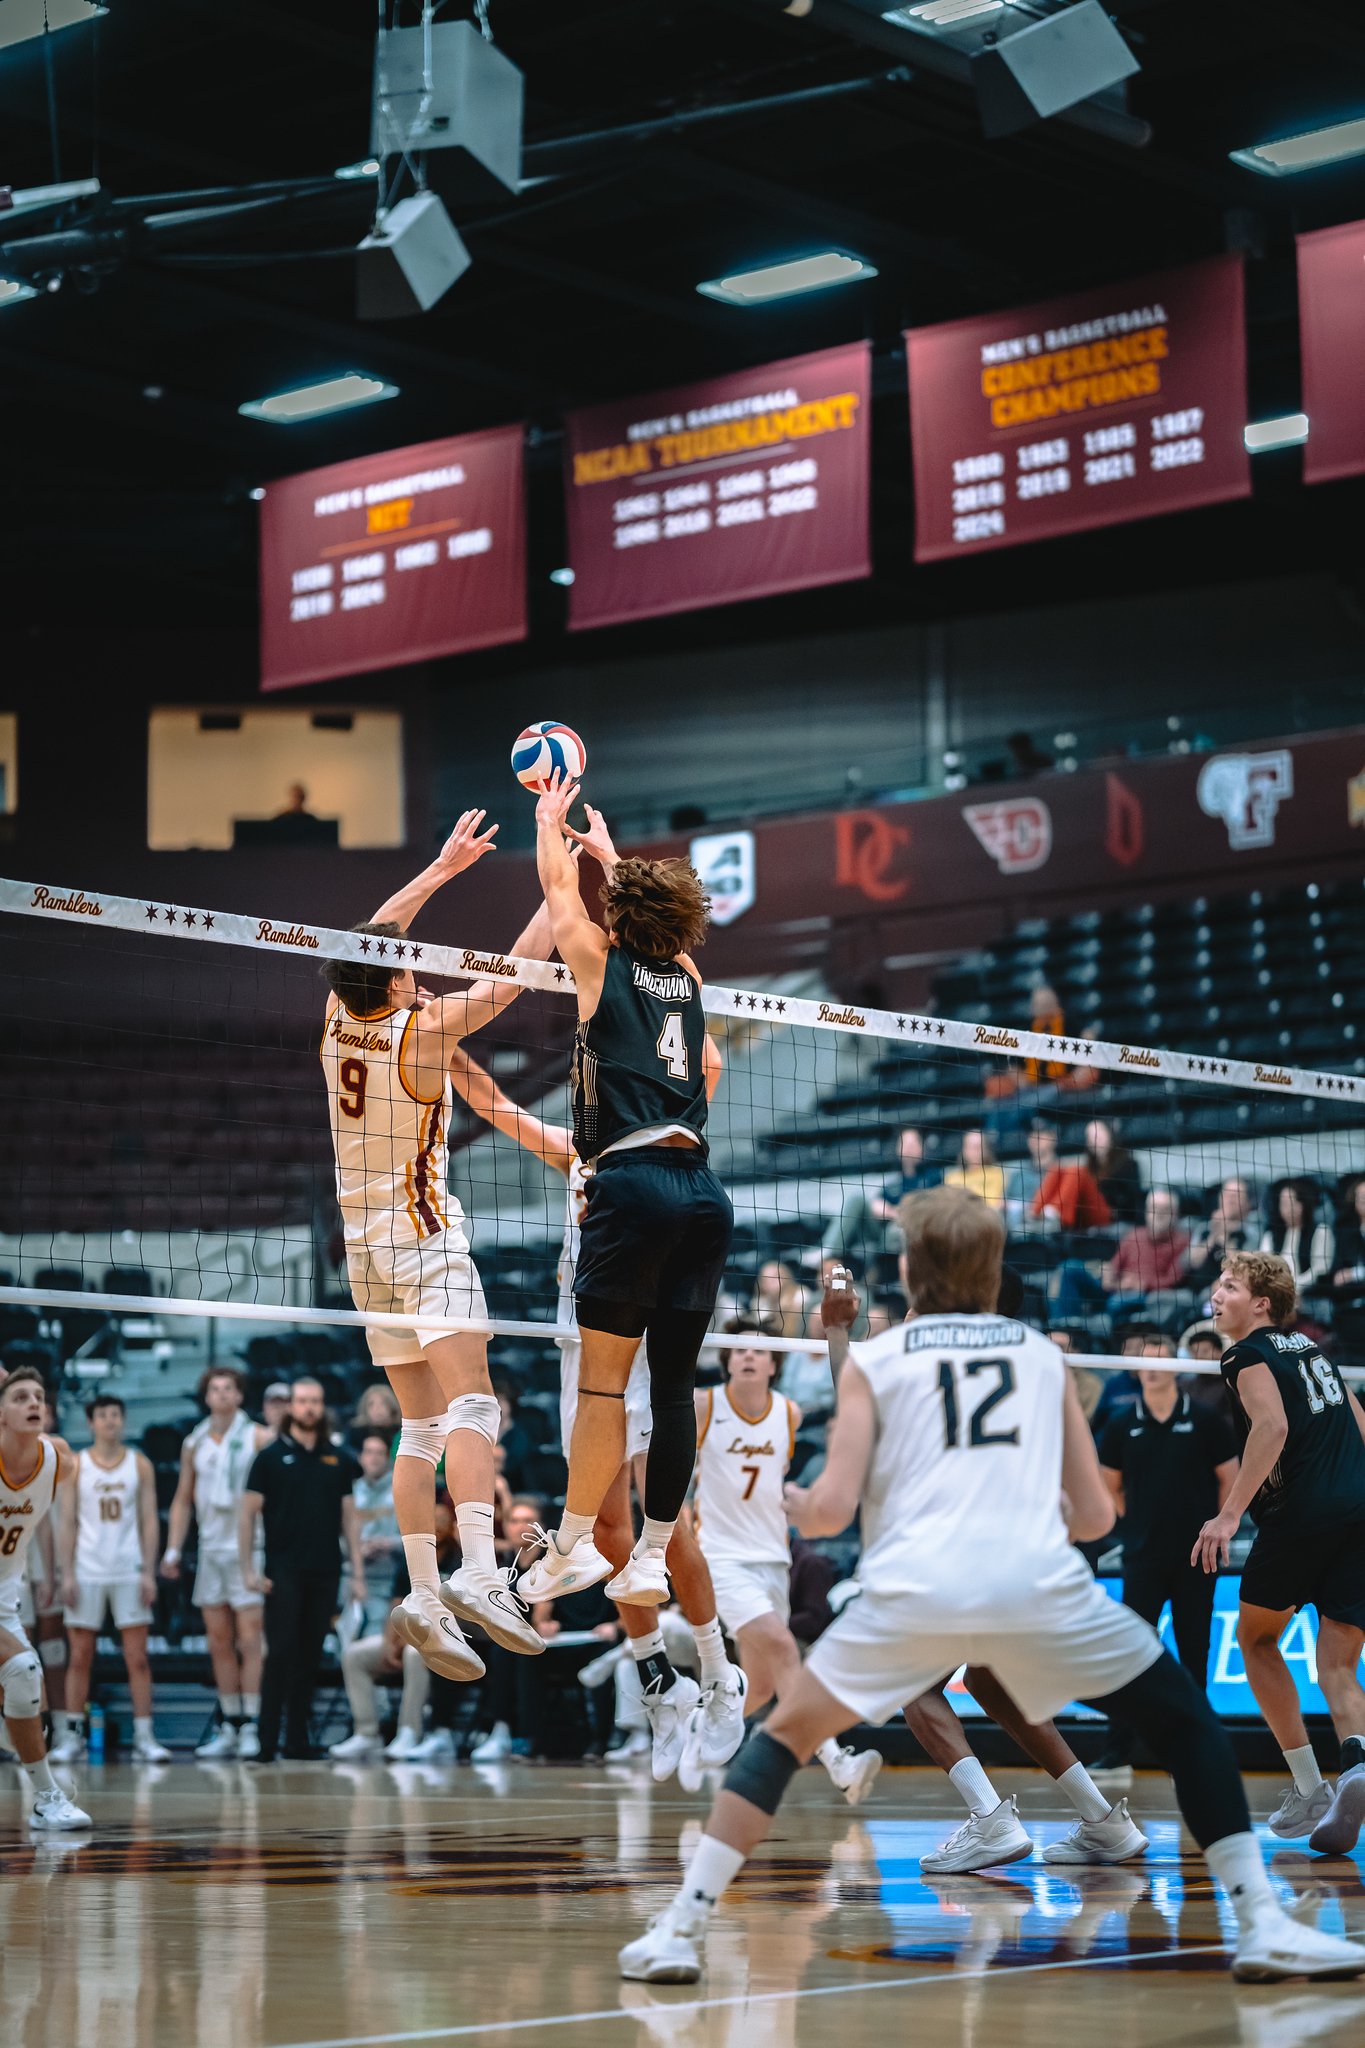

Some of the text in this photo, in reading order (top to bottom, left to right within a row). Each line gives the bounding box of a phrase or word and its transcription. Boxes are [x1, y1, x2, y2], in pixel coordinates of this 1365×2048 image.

[981, 304, 1168, 364] MEN'S BASKETBALL
[981, 327, 1169, 398] CONFERENCE
[991, 362, 1160, 428] CHAMPIONS
[573, 392, 859, 485] NCAA TOURNAMENT
[1151, 406, 1204, 440] 1987
[30, 886, 102, 916] Ramblers
[256, 920, 319, 949] Ramblers
[460, 950, 518, 978] Ramblers
[816, 1003, 866, 1028] Ramblers
[330, 1020, 392, 1052] Ramblers
[656, 1012, 689, 1081] 4
[973, 1025, 1019, 1049] Ramblers
[1118, 1046, 1161, 1068] Ramblers
[340, 1057, 368, 1120] 9
[1252, 1064, 1293, 1086] Ramblers
[905, 1322, 1025, 1353] LINDENWOOD
[1298, 1355, 1344, 1414] 16
[936, 1357, 1020, 1451] 12
[726, 1437, 775, 1459] Loyola
[741, 1466, 761, 1501] 7
[0, 1498, 33, 1519] oyola
[99, 1497, 122, 1524] 10
